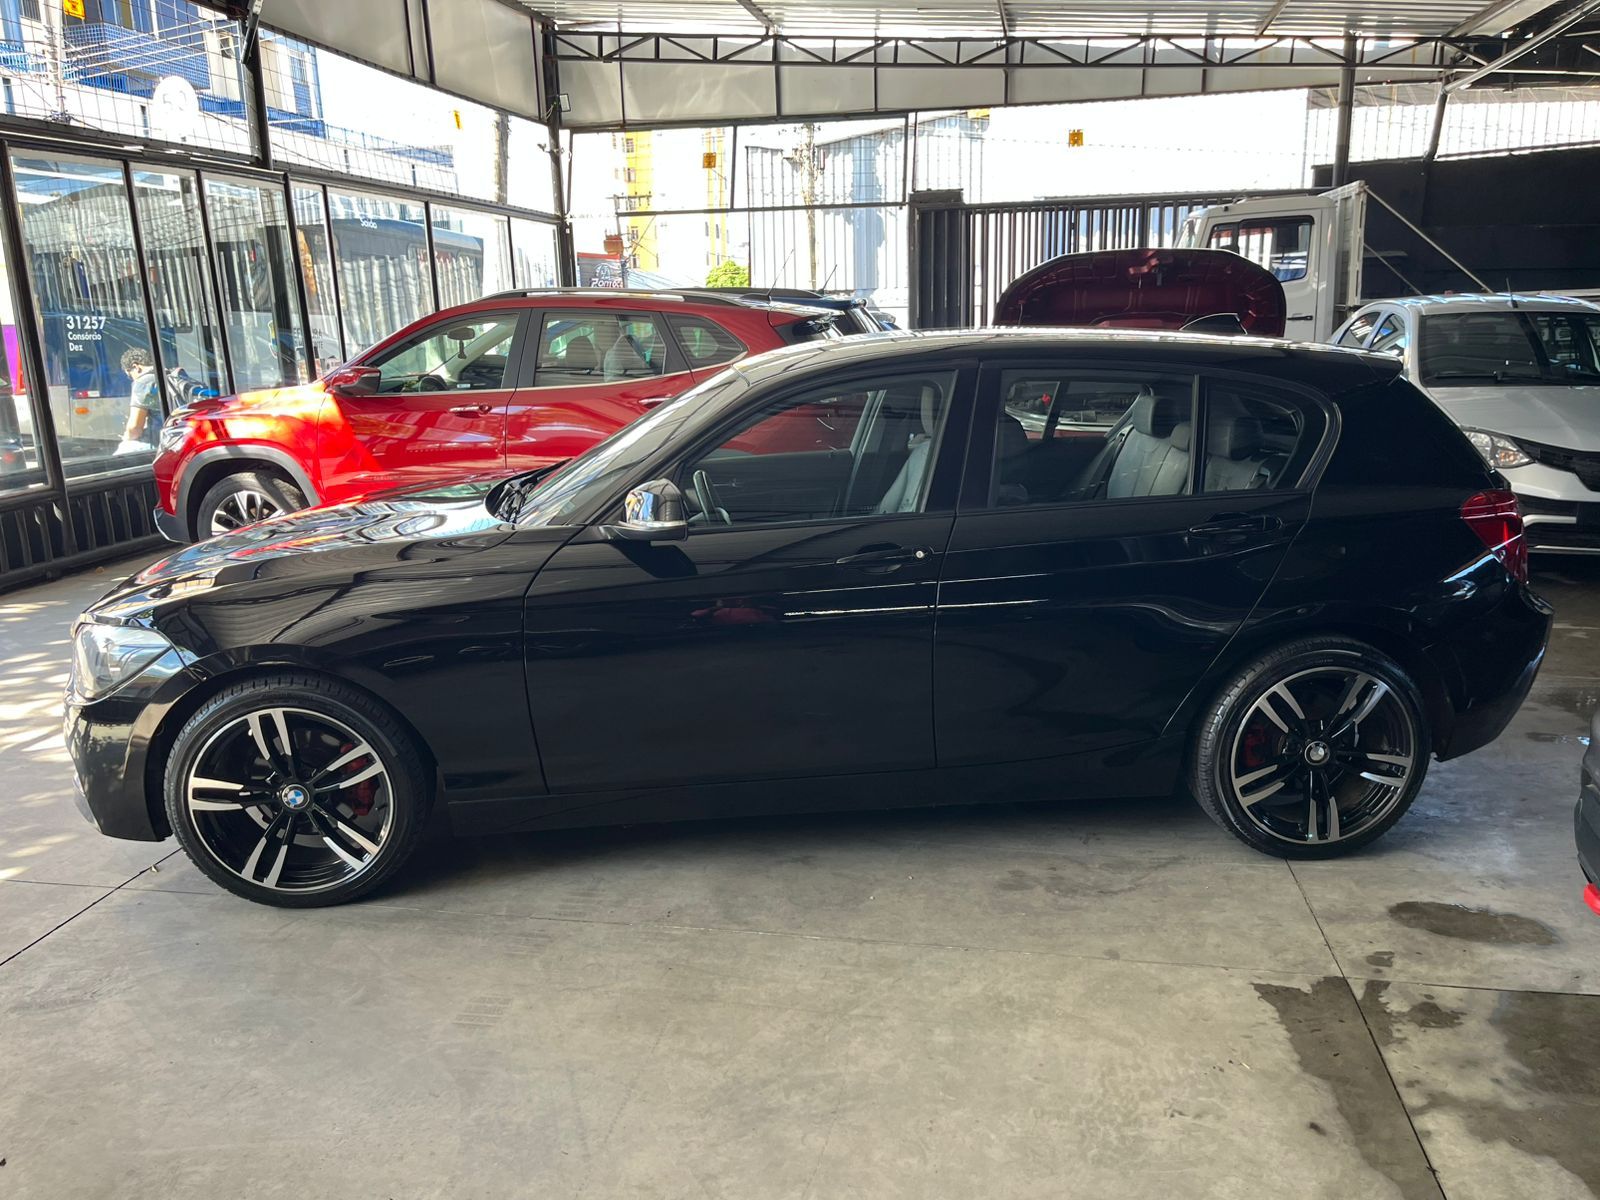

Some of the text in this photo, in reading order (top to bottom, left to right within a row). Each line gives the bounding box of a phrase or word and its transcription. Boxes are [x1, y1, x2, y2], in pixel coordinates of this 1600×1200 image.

[66, 315, 106, 329] 31257
[67, 331, 102, 340] Consórcio
[69, 342, 84, 351] Dez
